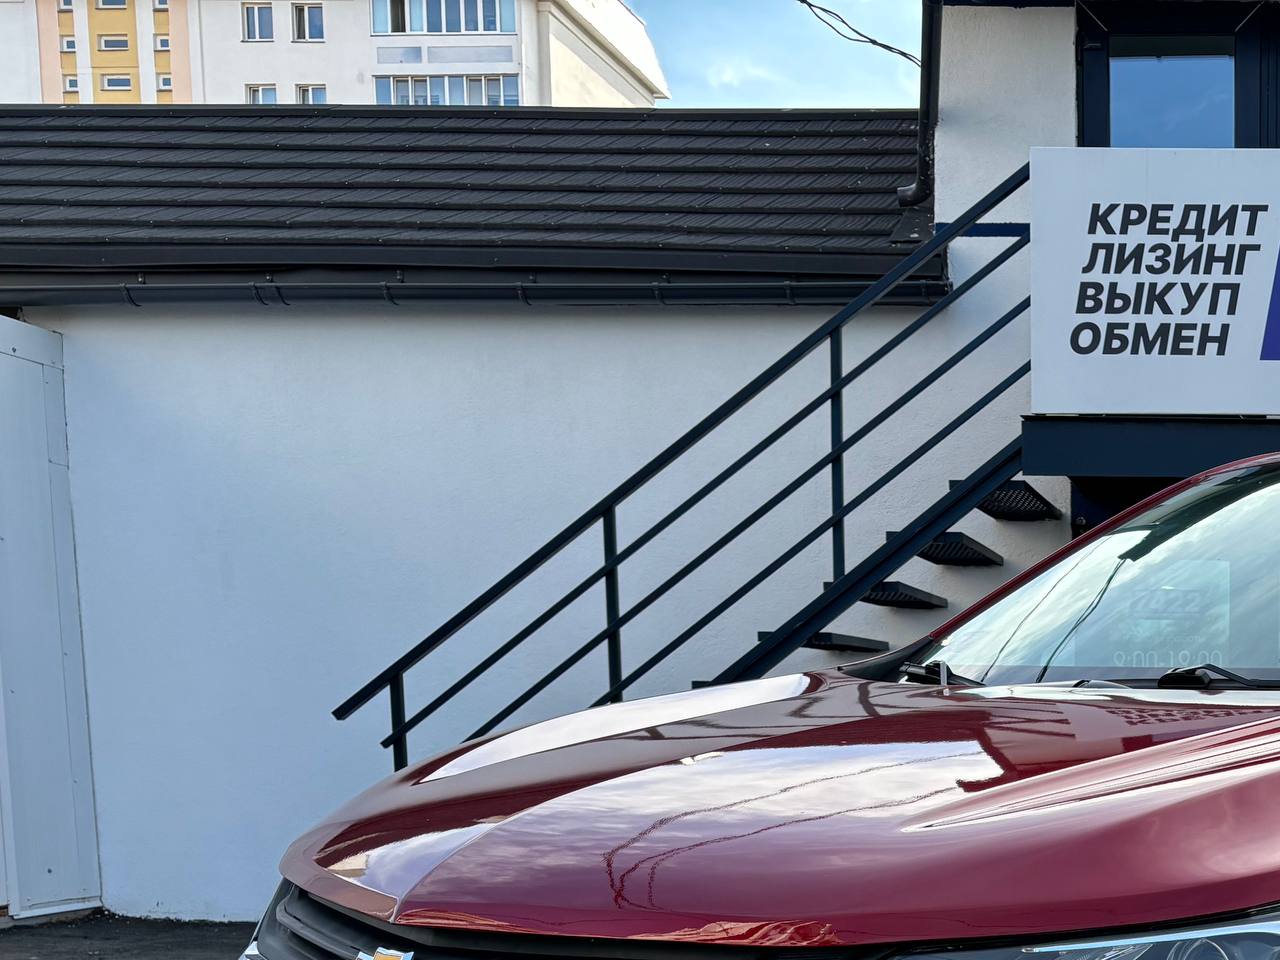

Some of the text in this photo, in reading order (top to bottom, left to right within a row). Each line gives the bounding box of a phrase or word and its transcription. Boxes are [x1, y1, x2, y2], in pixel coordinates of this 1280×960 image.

[1087, 202, 1269, 242] КРЕДИТ
[1081, 242, 1261, 276] ЛИЗИНГ
[1075, 282, 1242, 316] ВЫКУП
[1069, 321, 1230, 357] ОБМЕН
